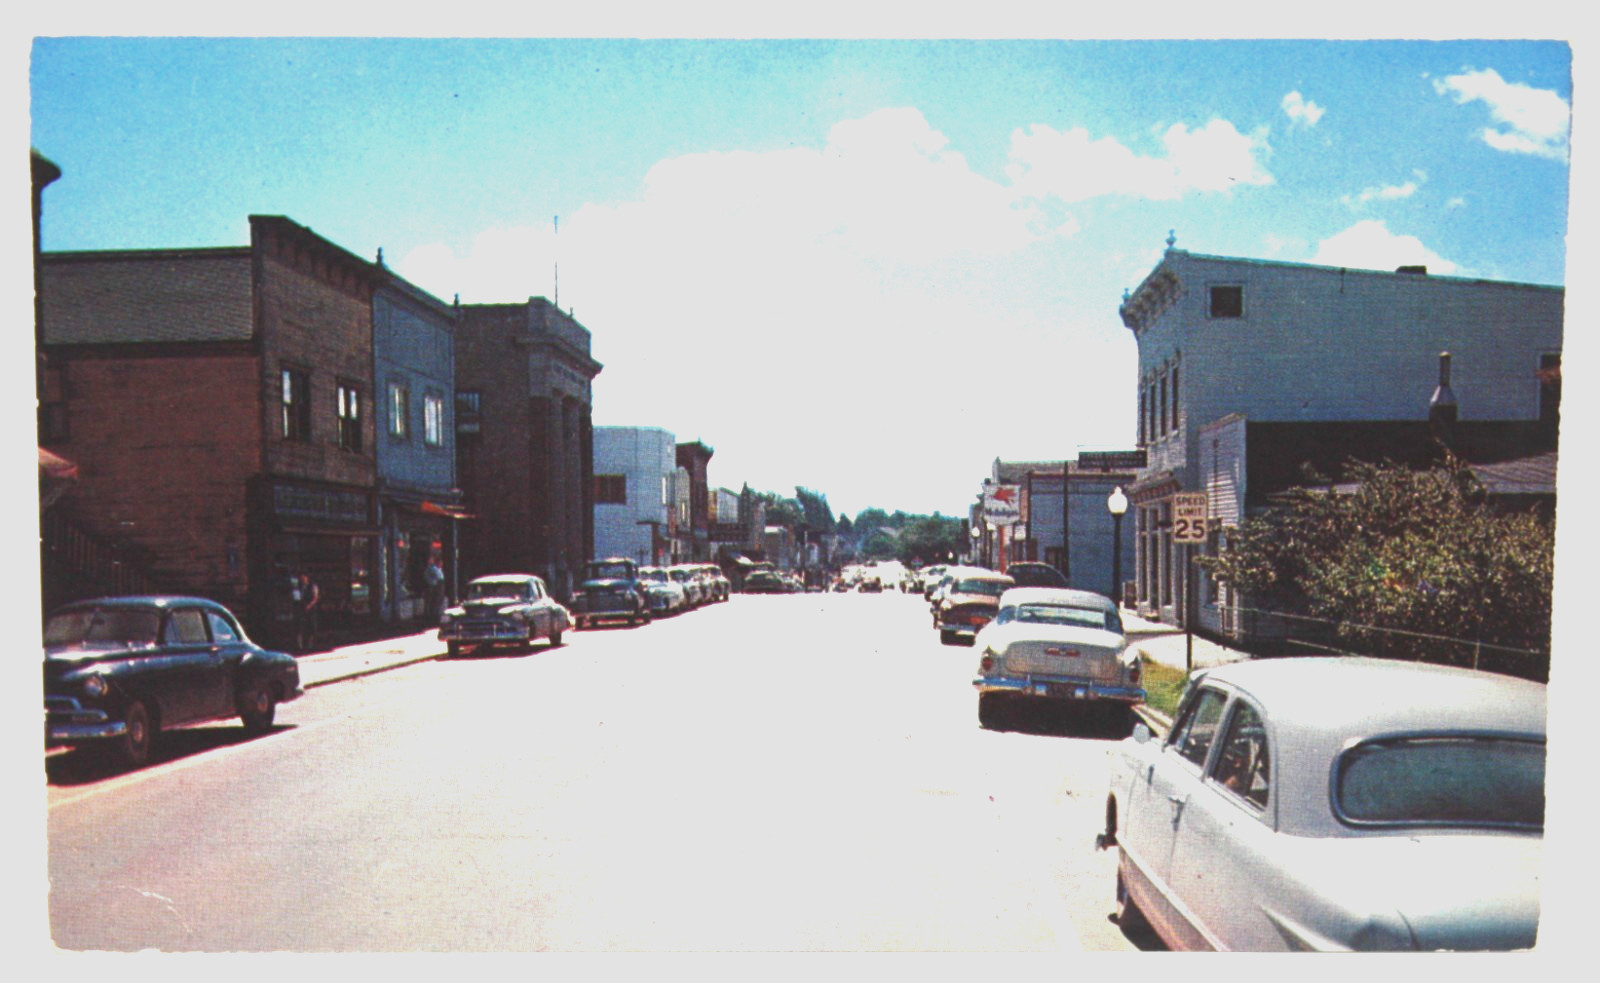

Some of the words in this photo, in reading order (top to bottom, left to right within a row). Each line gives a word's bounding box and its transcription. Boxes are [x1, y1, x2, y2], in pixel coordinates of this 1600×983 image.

[1176, 496, 1206, 506] SPEED
[1178, 507, 1203, 517] LIMIT
[1175, 518, 1205, 539] 25
